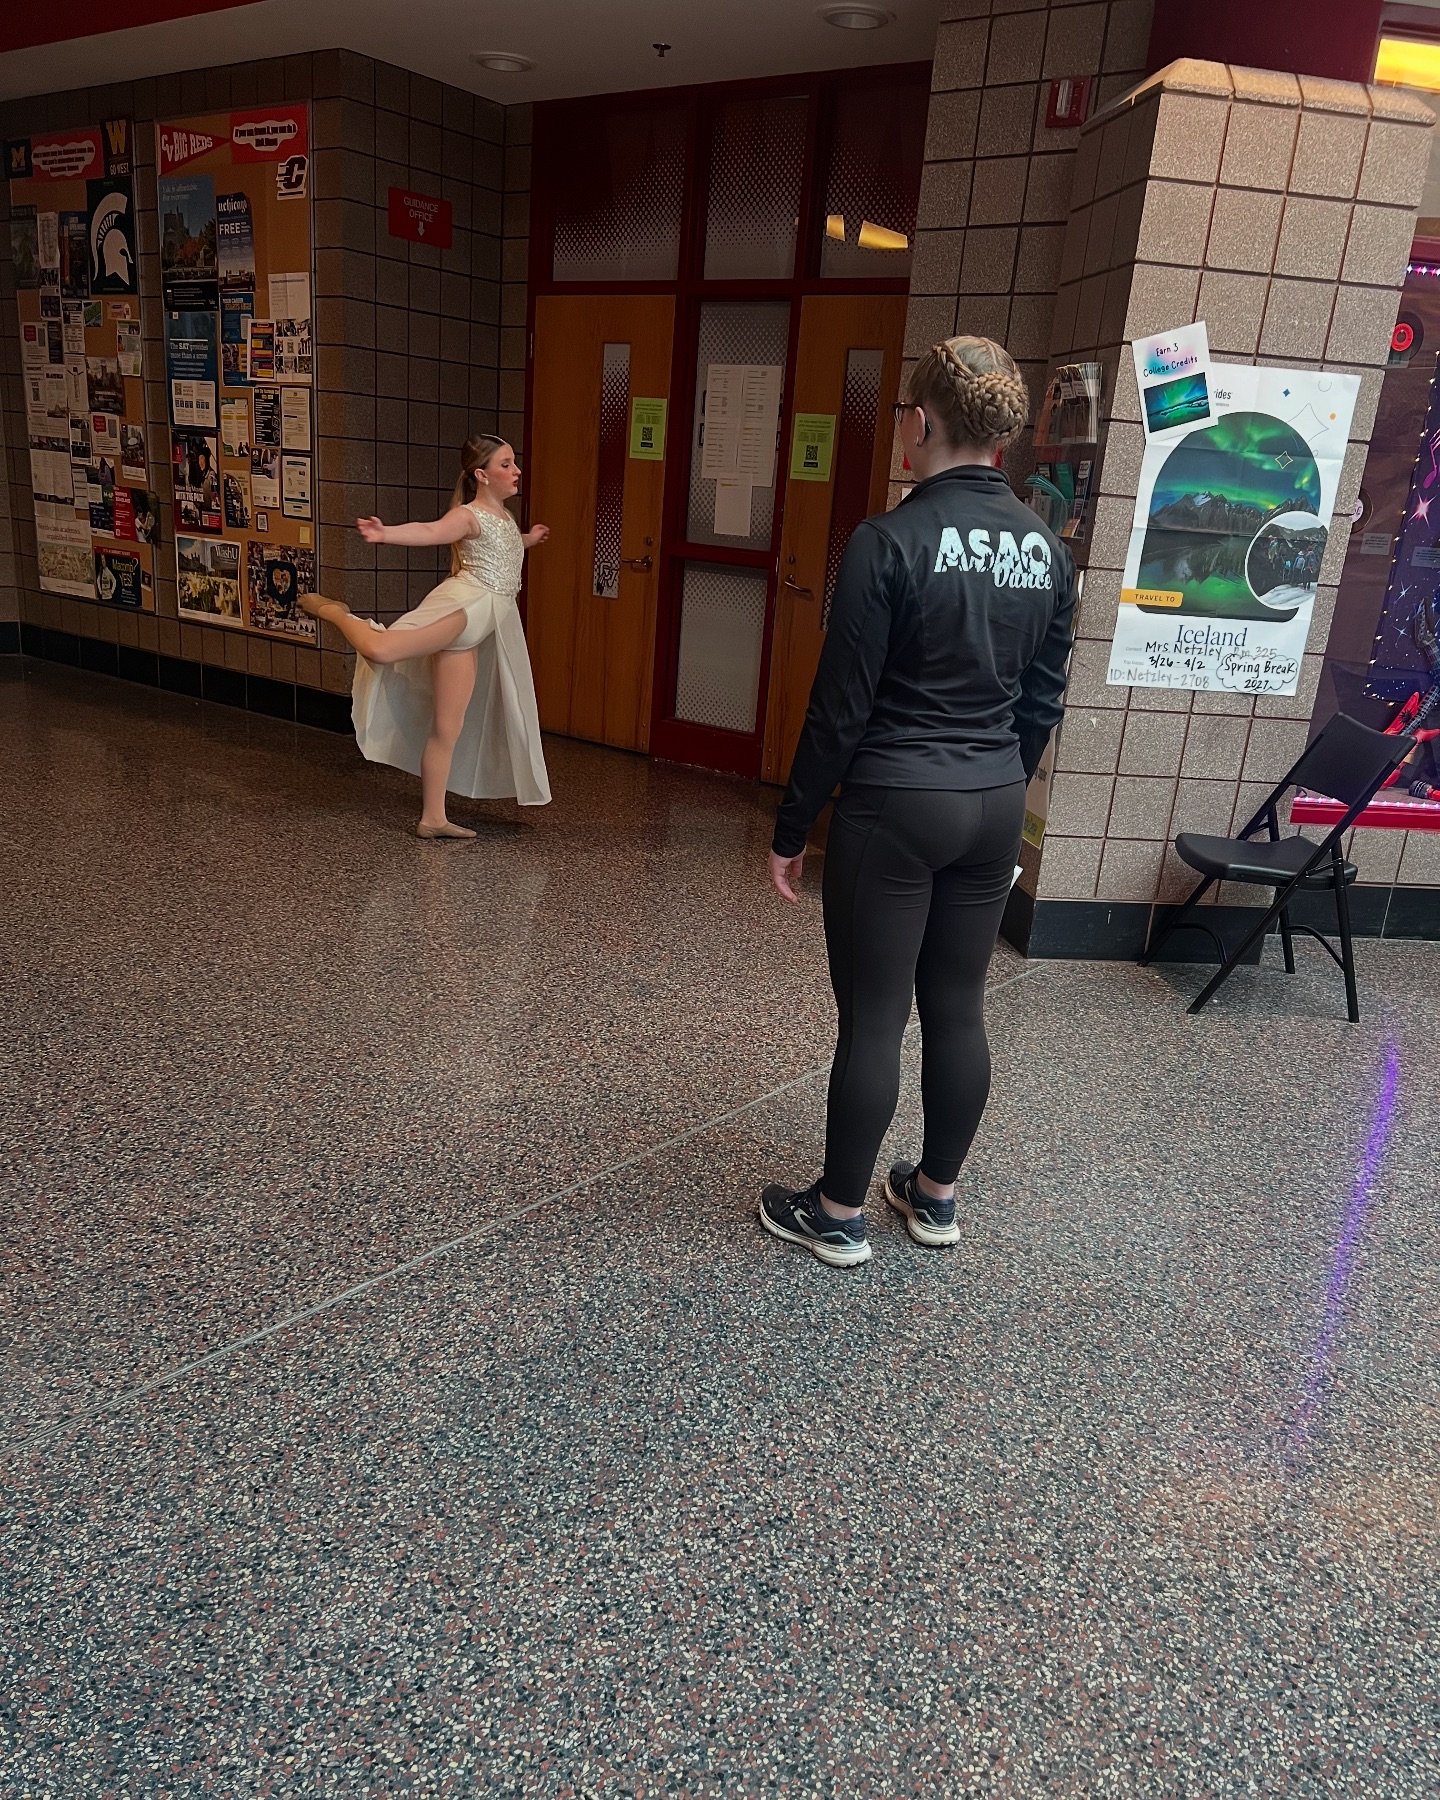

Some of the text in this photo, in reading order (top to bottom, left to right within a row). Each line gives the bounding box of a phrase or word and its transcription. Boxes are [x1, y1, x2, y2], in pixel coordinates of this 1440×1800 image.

[106, 119, 126, 154] W
[173, 131, 188, 162] BIG
[189, 133, 213, 155] REDS
[10, 146, 26, 168] M
[109, 164, 117, 175] GO
[403, 196, 439, 213] GUIDANCE
[409, 208, 434, 223] OFFICE
[219, 222, 241, 235] FREE
[178, 342, 190, 350] SAT
[1155, 346, 1171, 357] Earn
[1143, 355, 1198, 378] College Credits
[214, 545, 238, 560] WashU
[993, 561, 1053, 590] Dance
[1134, 593, 1163, 602] TRAVEL
[1176, 624, 1248, 647] Iceland
[1145, 641, 1171, 653] Mrs.
[1173, 641, 1223, 661] Netzley
[1255, 646, 1278, 657] 325
[1148, 653, 1174, 669] 3/26
[1184, 656, 1206, 672] 4/2
[1224, 655, 1260, 679] Spring
[1243, 678, 1270, 690] 2027
